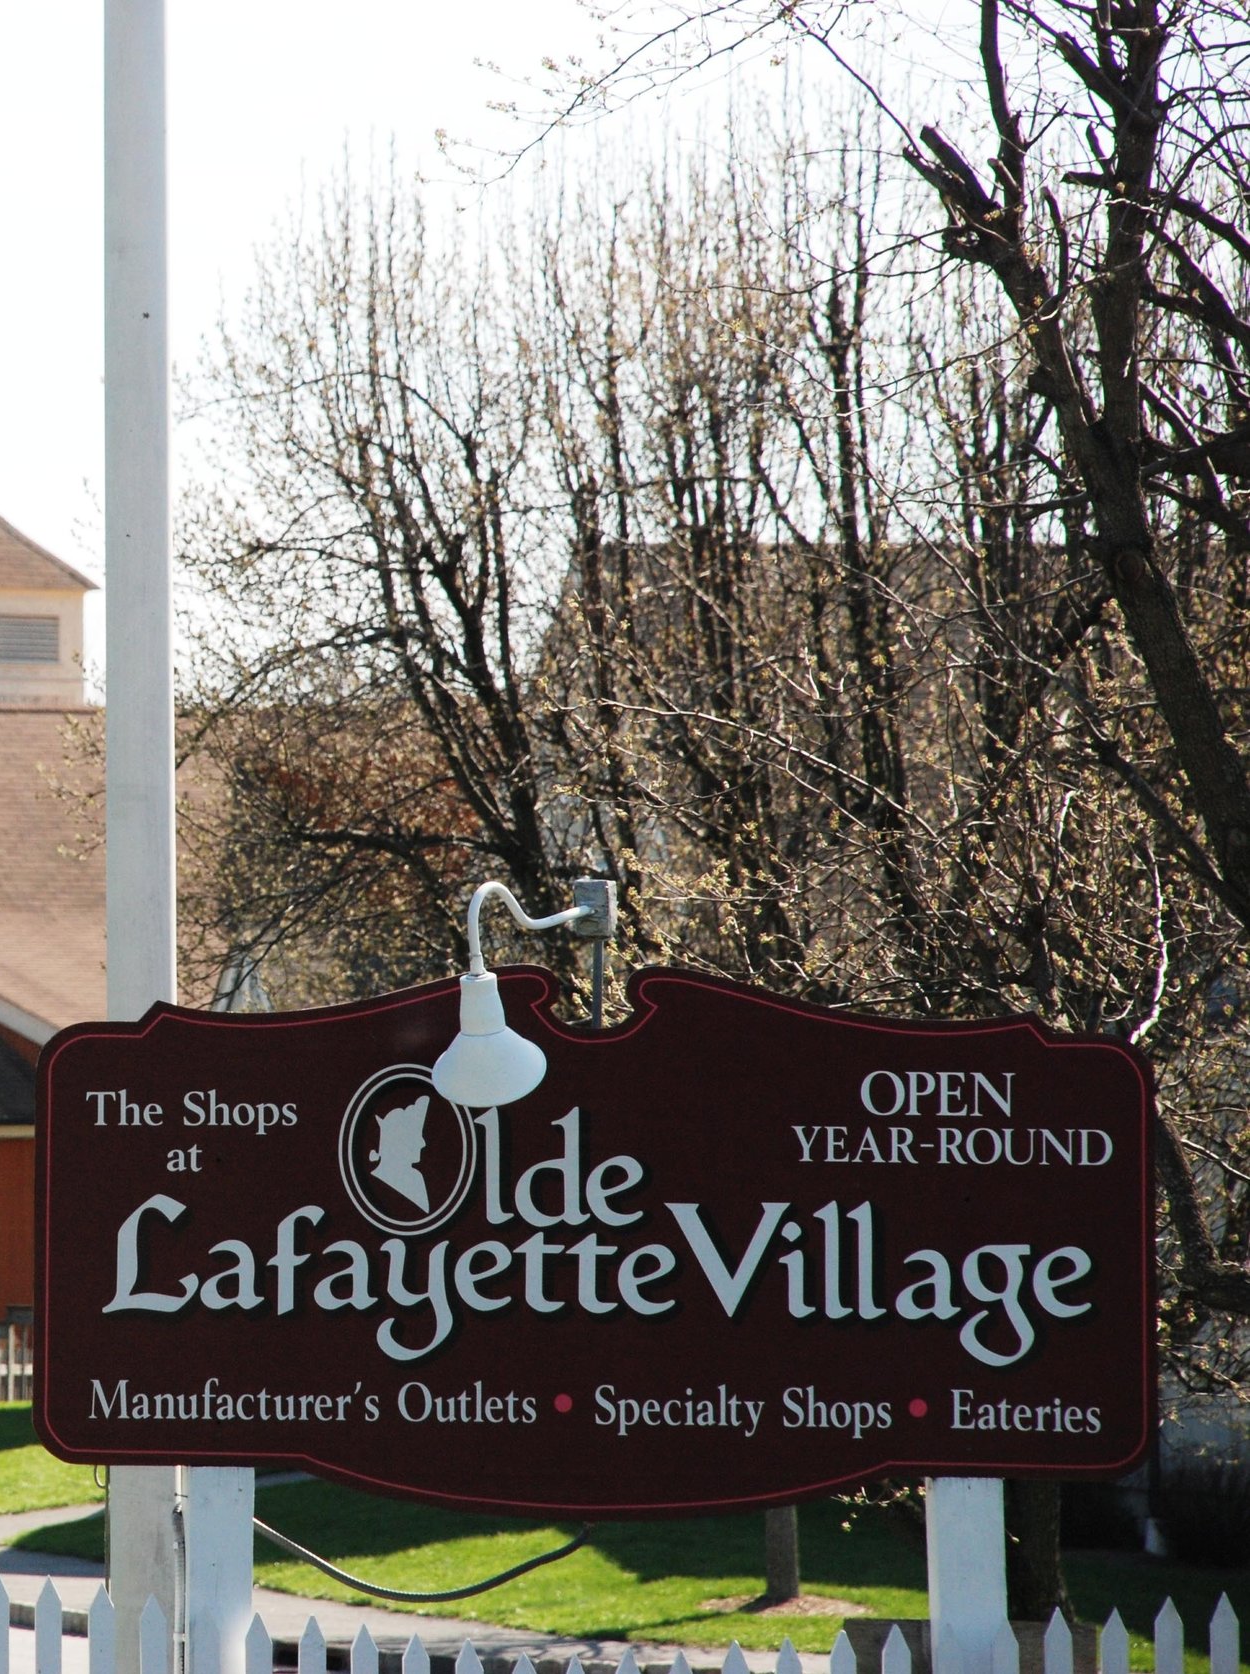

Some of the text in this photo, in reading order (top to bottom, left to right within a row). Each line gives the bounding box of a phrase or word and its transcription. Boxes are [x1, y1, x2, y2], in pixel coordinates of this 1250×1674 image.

[85, 1088, 299, 1136] The Shops
[860, 1070, 1016, 1118] OPEN
[166, 1143, 203, 1173] at
[791, 1125, 1114, 1167] YEAR-ROUND
[101, 1193, 1093, 1367] Lafayette Village
[88, 1377, 1102, 1439] Manufacturer's Outlets Specialty Shops Eateries
